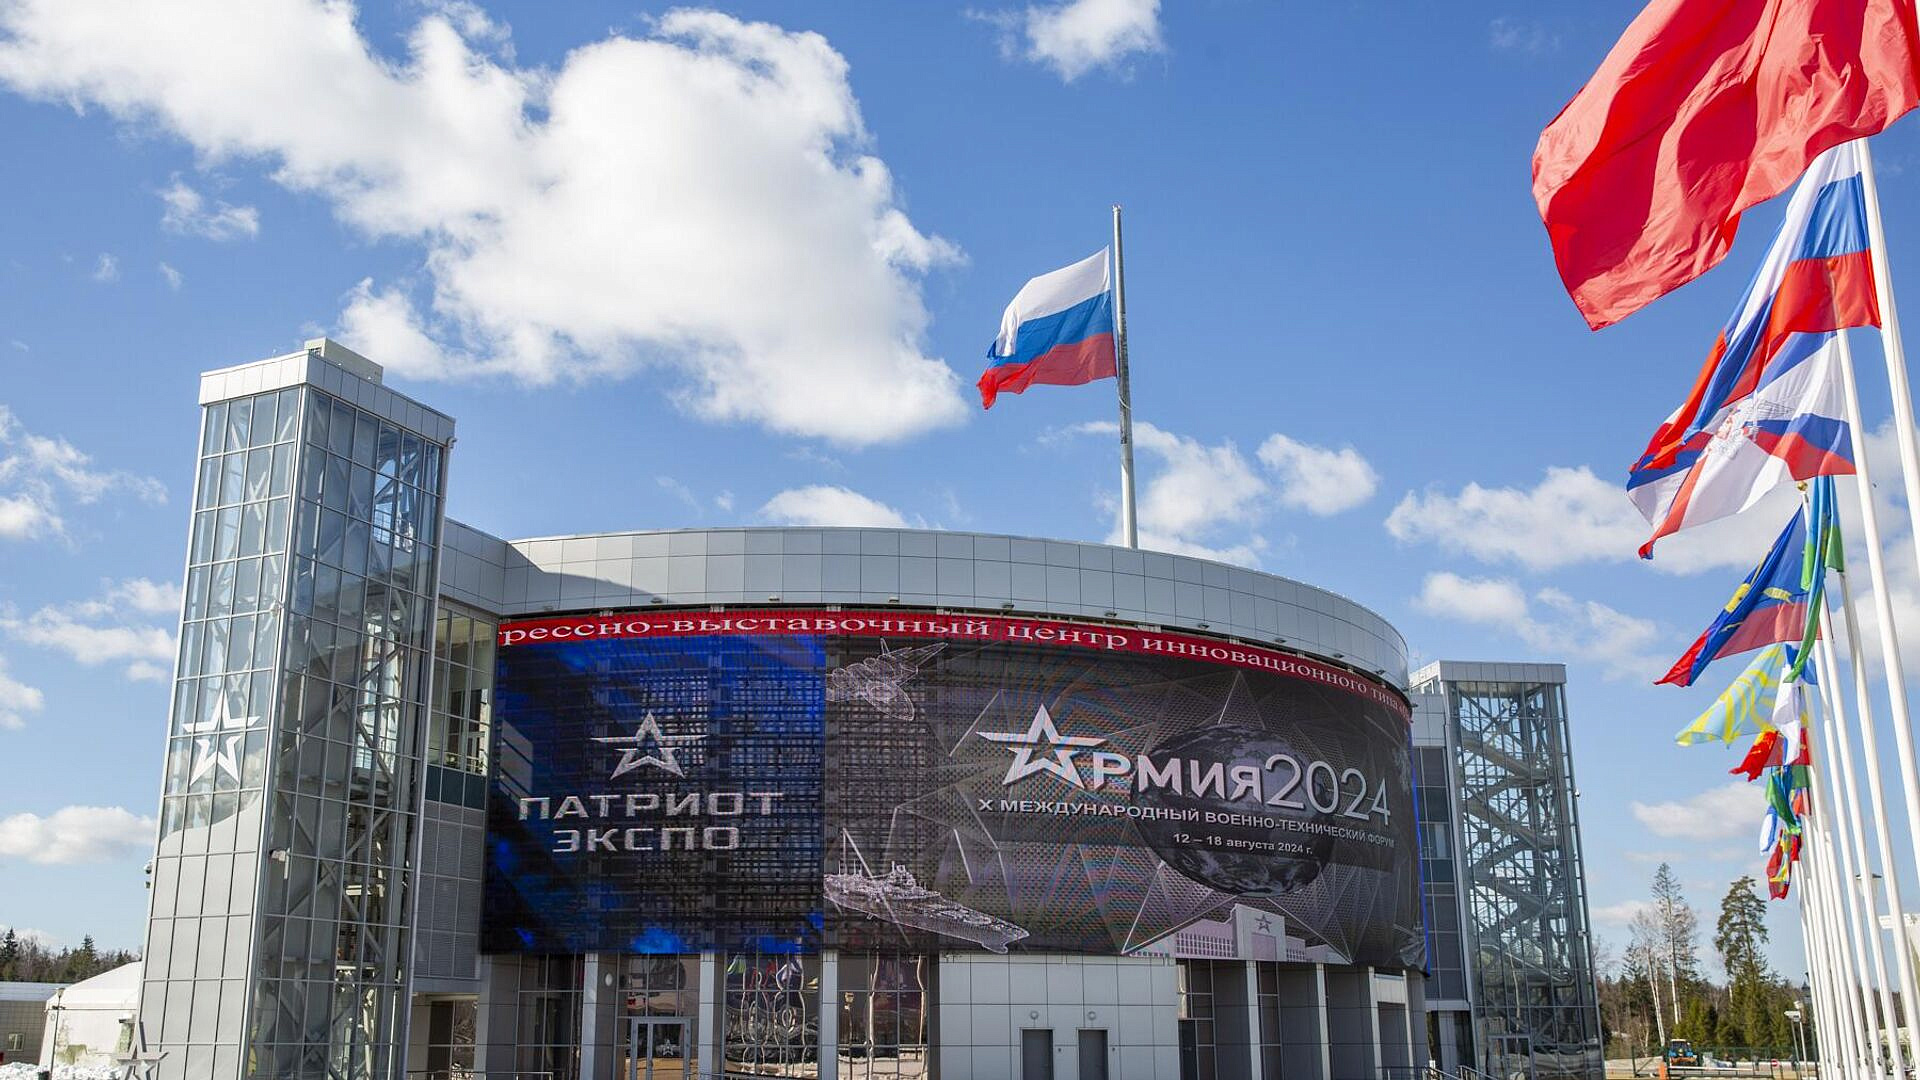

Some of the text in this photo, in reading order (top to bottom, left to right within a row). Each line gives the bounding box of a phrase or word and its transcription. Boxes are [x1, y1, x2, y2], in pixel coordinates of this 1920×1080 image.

[498, 617, 1398, 710] рессно-выставочный центр инновационного типа
[518, 792, 785, 820] ПАТРИОТ
[999, 799, 1200, 821] МЕЖДУНАРОДНЫЙ
[1205, 811, 1366, 841] ВОЕННО-ТЕХНИЧЕСКИЙ
[1367, 831, 1395, 848] ФОРУМ
[552, 826, 740, 852] ЭКСПО
[1174, 833, 1190, 844] 12
[1206, 835, 1222, 846] 18
[1226, 838, 1275, 851] августа
[1278, 842, 1303, 853] 2024
[1306, 846, 1313, 855] г.
